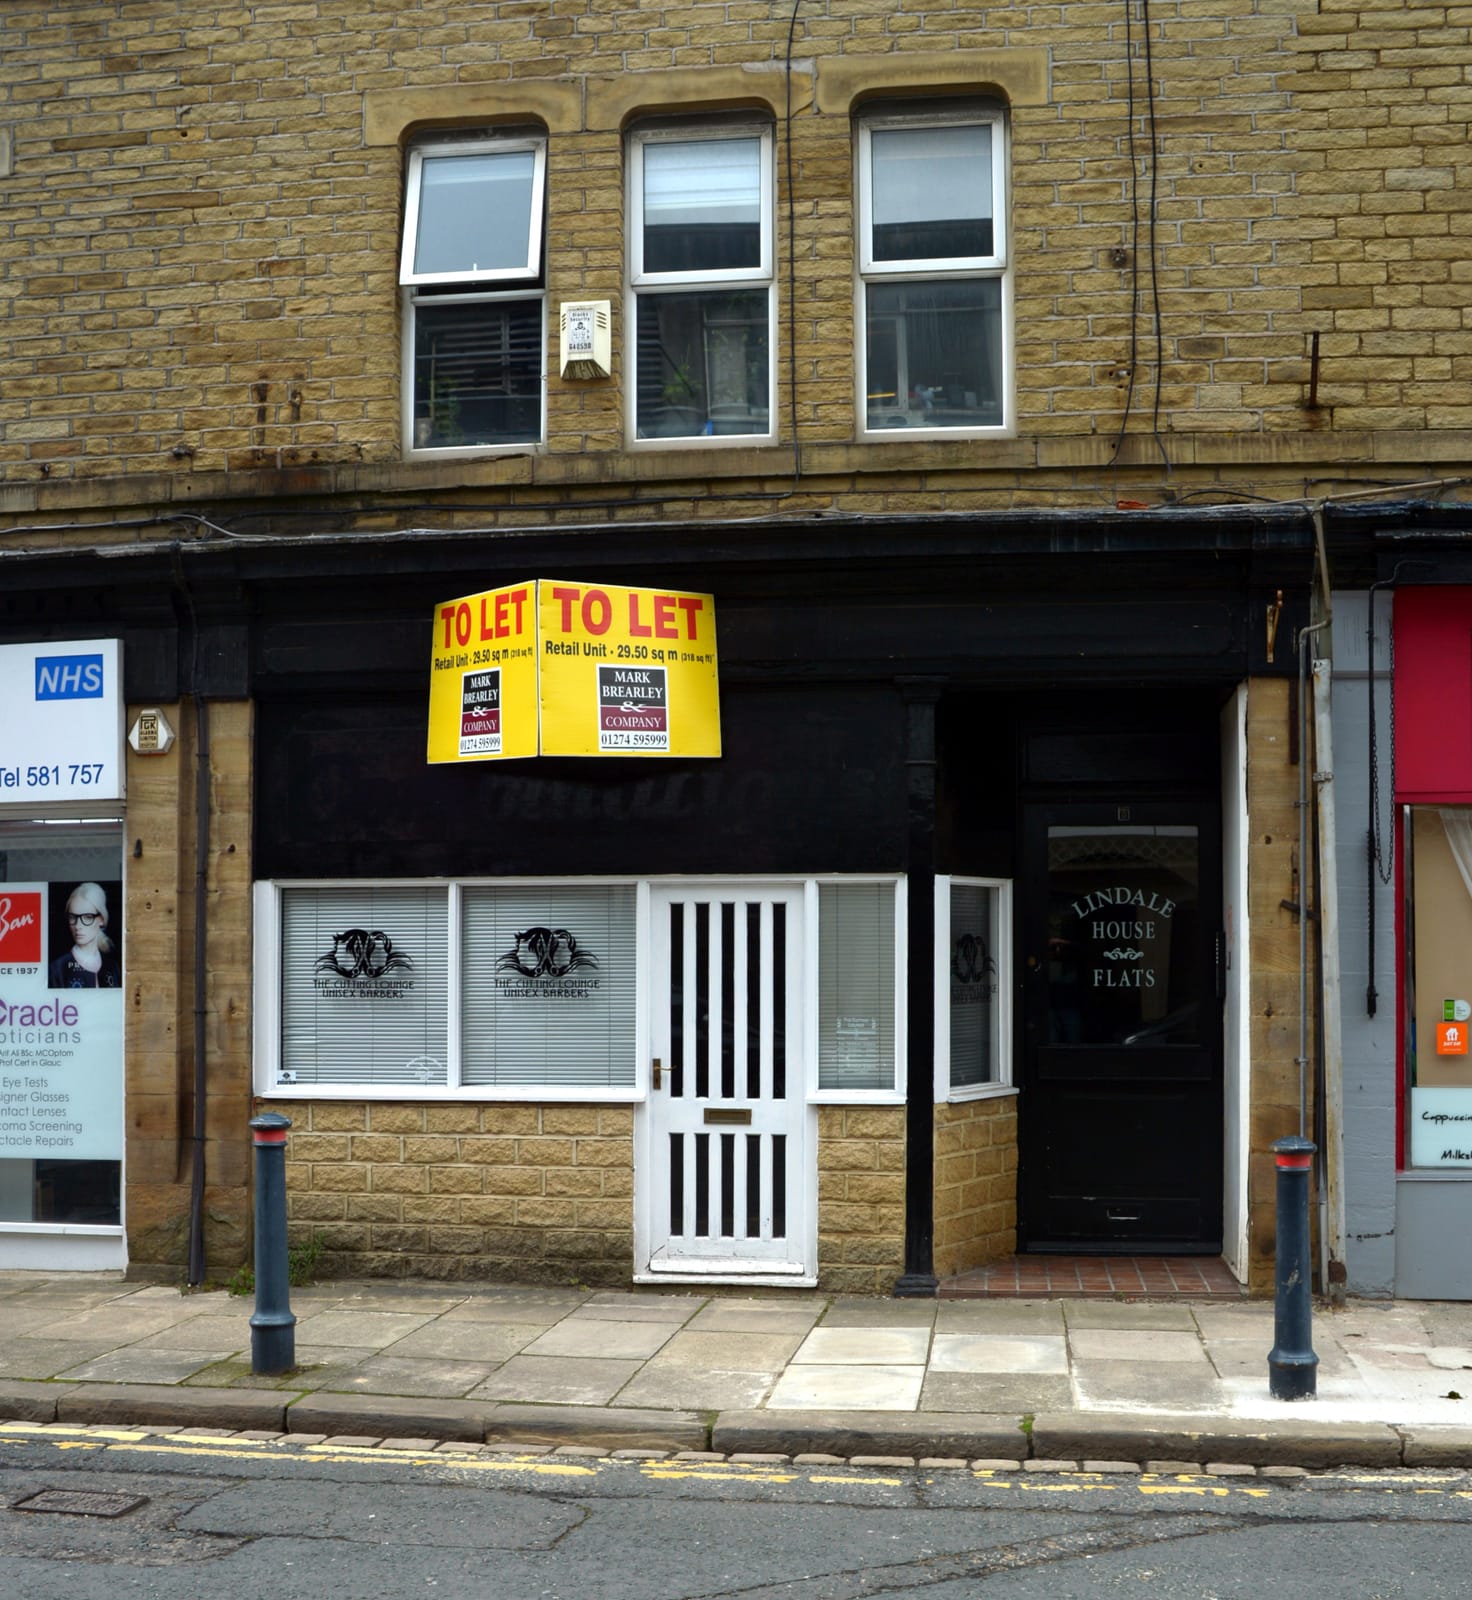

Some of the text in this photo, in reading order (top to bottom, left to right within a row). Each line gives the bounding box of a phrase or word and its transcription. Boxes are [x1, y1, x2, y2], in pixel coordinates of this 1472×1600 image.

[441, 589, 527, 649] TO LET
[553, 587, 703, 641] TO LET
[545, 640, 579, 656] Retail
[583, 643, 607, 657] Unit
[617, 644, 648, 659] 29.50
[651, 649, 665, 663] sq
[668, 650, 678, 661] m
[434, 656, 454, 671] Retail
[456, 653, 469, 668] Unit
[473, 649, 490, 665] 29.50
[492, 650, 500, 664] sq
[502, 648, 509, 659] m
[38, 664, 102, 694] NHS
[470, 674, 491, 689] MARK
[614, 671, 651, 683] MARK
[463, 689, 498, 705] BREARLEY
[602, 685, 663, 698] BREARLEY
[472, 705, 488, 717] &
[620, 700, 647, 713] &
[463, 719, 497, 733] COMPANY
[605, 716, 661, 728] COMPANY
[460, 736, 501, 751] 01274 595999
[601, 734, 667, 745] 01274 595999
[26, 765, 60, 786] 581
[68, 764, 104, 785] 757
[1071, 887, 1177, 919] LINDALE
[1092, 921, 1156, 939] HOUSE
[16, 967, 39, 975] 1937
[1093, 969, 1155, 987] FLATS
[313, 979, 415, 990] THE CUTTING LOUNGE
[495, 978, 600, 989] THE CUTTING LOUNGE
[322, 989, 404, 999] UNISEX BARBERS
[503, 988, 589, 998] UNISEX BARBERS
[2, 1076, 49, 1090] Eye Tests
[30, 1091, 70, 1102] Glasses
[32, 1106, 67, 1117] Lenses
[29, 1120, 83, 1134] Screening
[35, 1135, 74, 1148] Repairs
